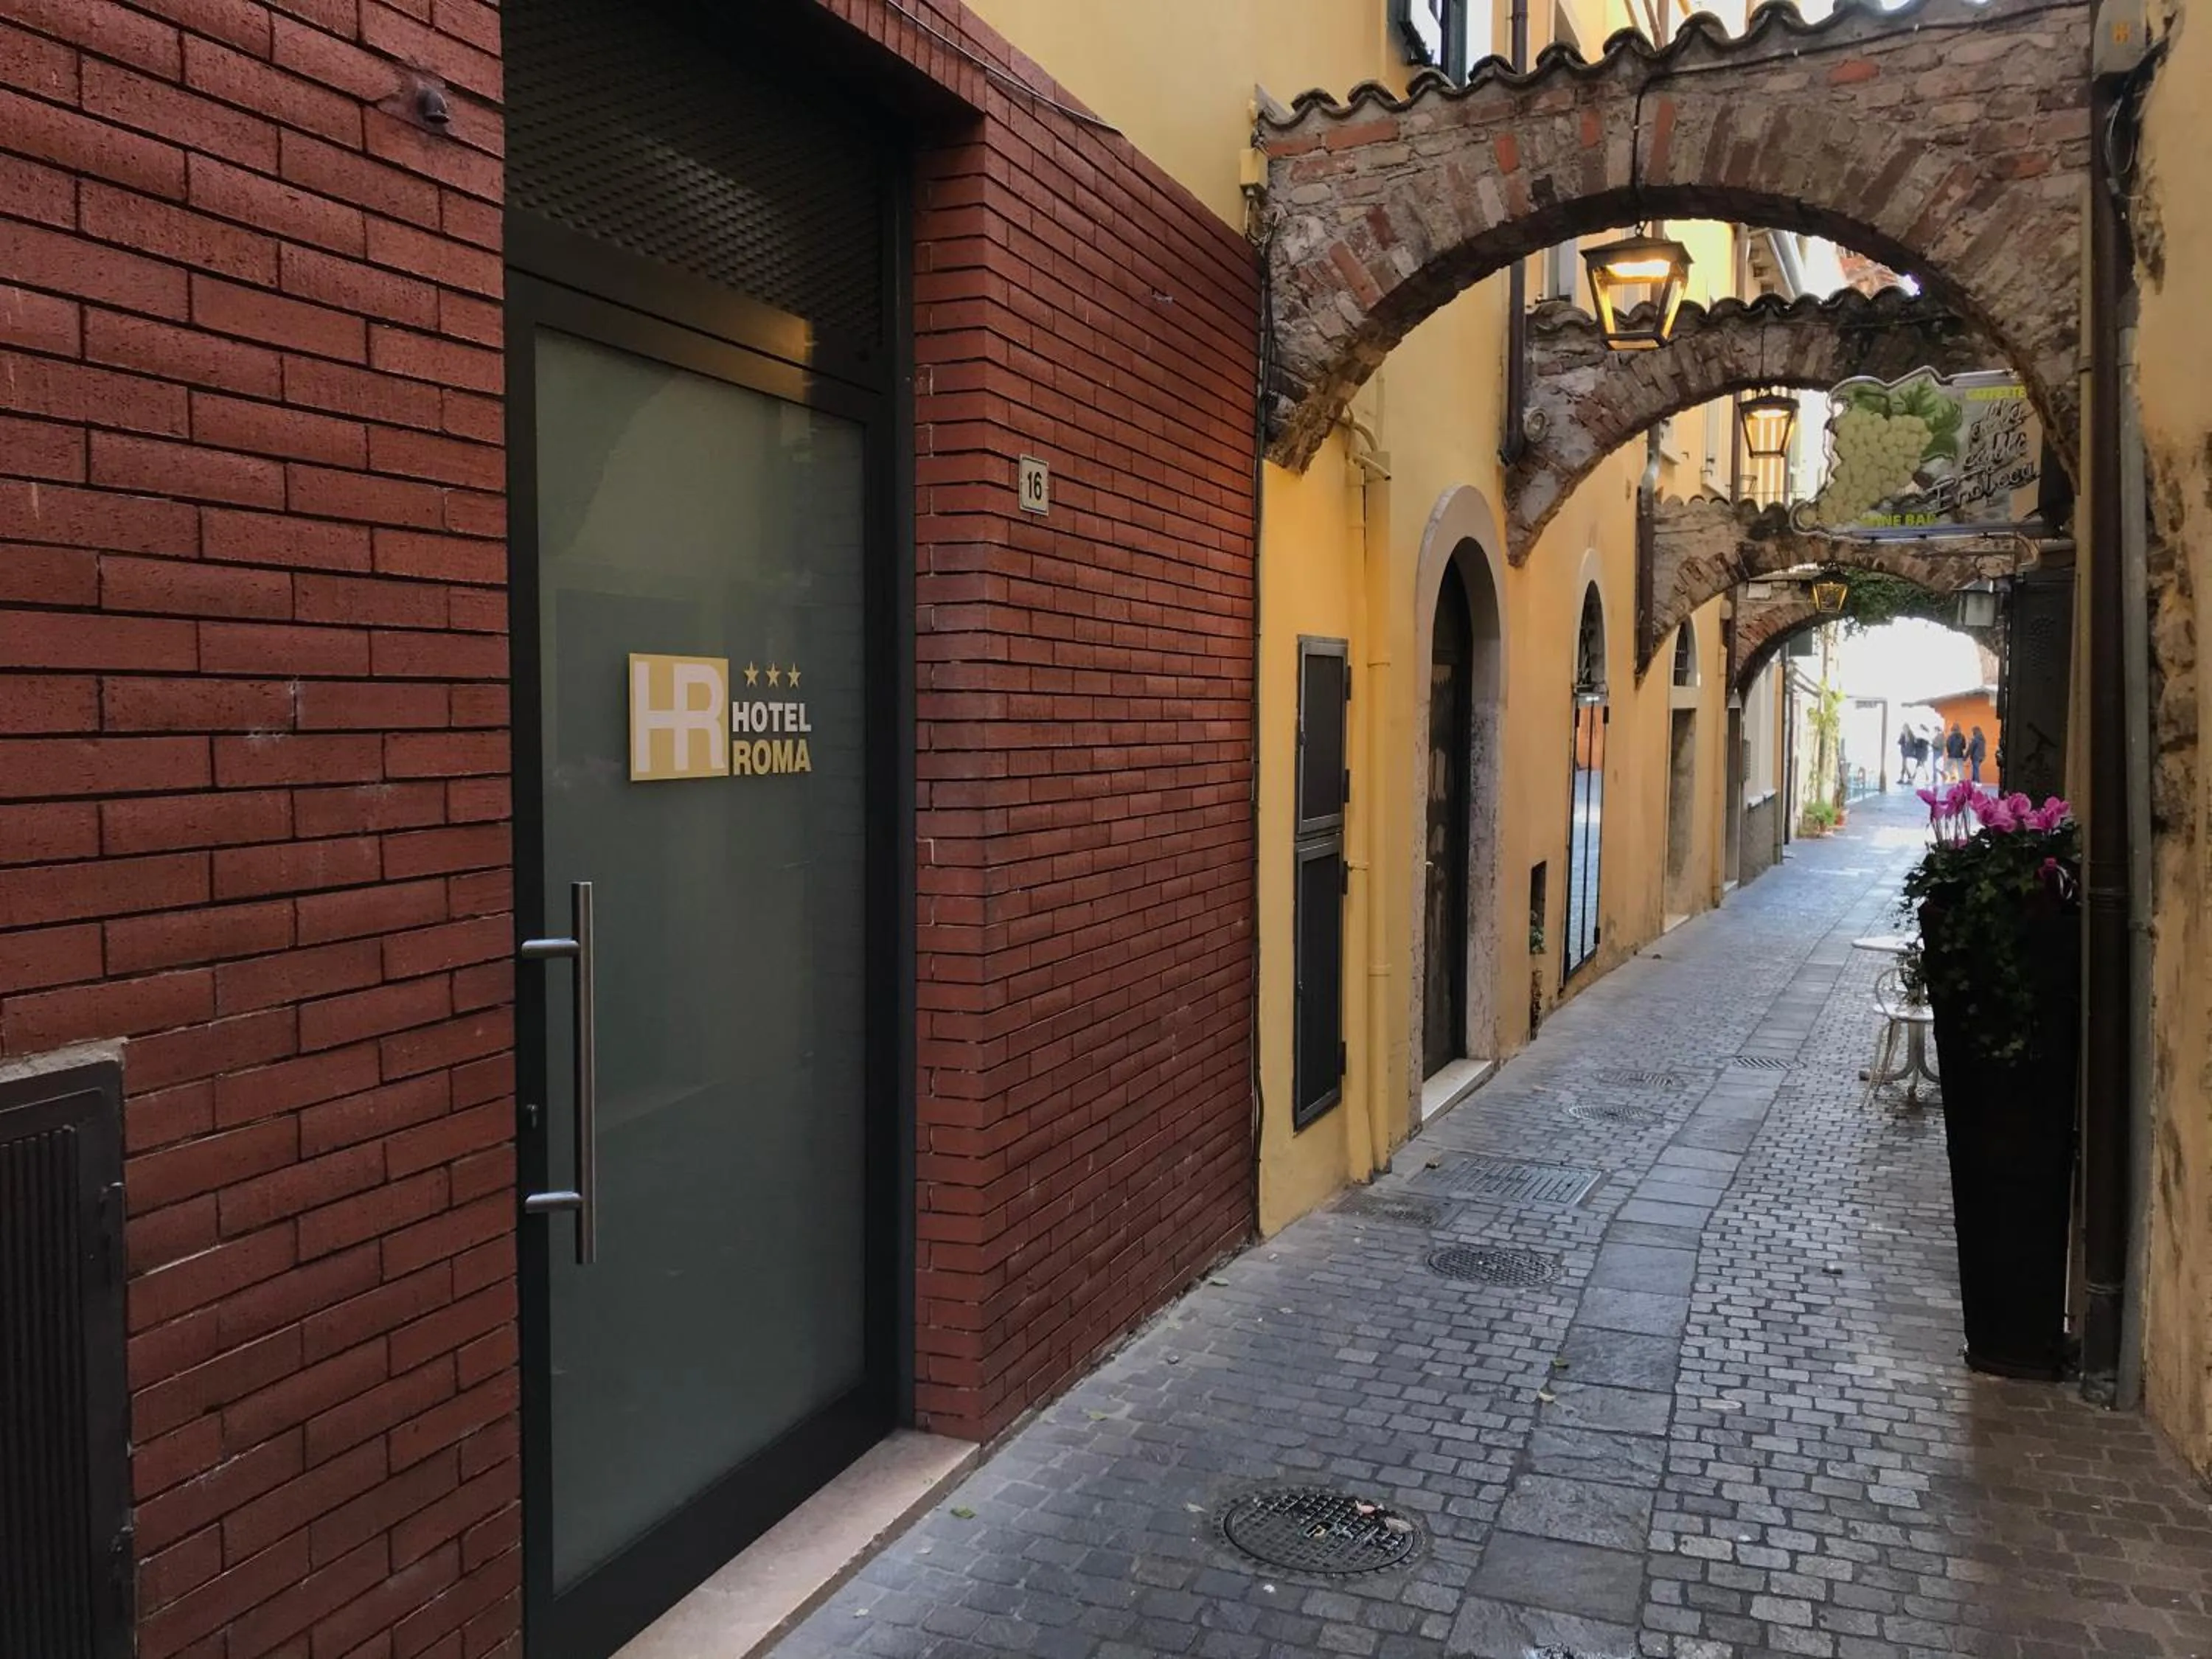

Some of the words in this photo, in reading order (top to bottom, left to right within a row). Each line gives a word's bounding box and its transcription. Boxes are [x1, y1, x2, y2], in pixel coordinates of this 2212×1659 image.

[1027, 471, 1042, 501] 16
[731, 701, 812, 732] HOTEL
[732, 739, 812, 776] ROMA
